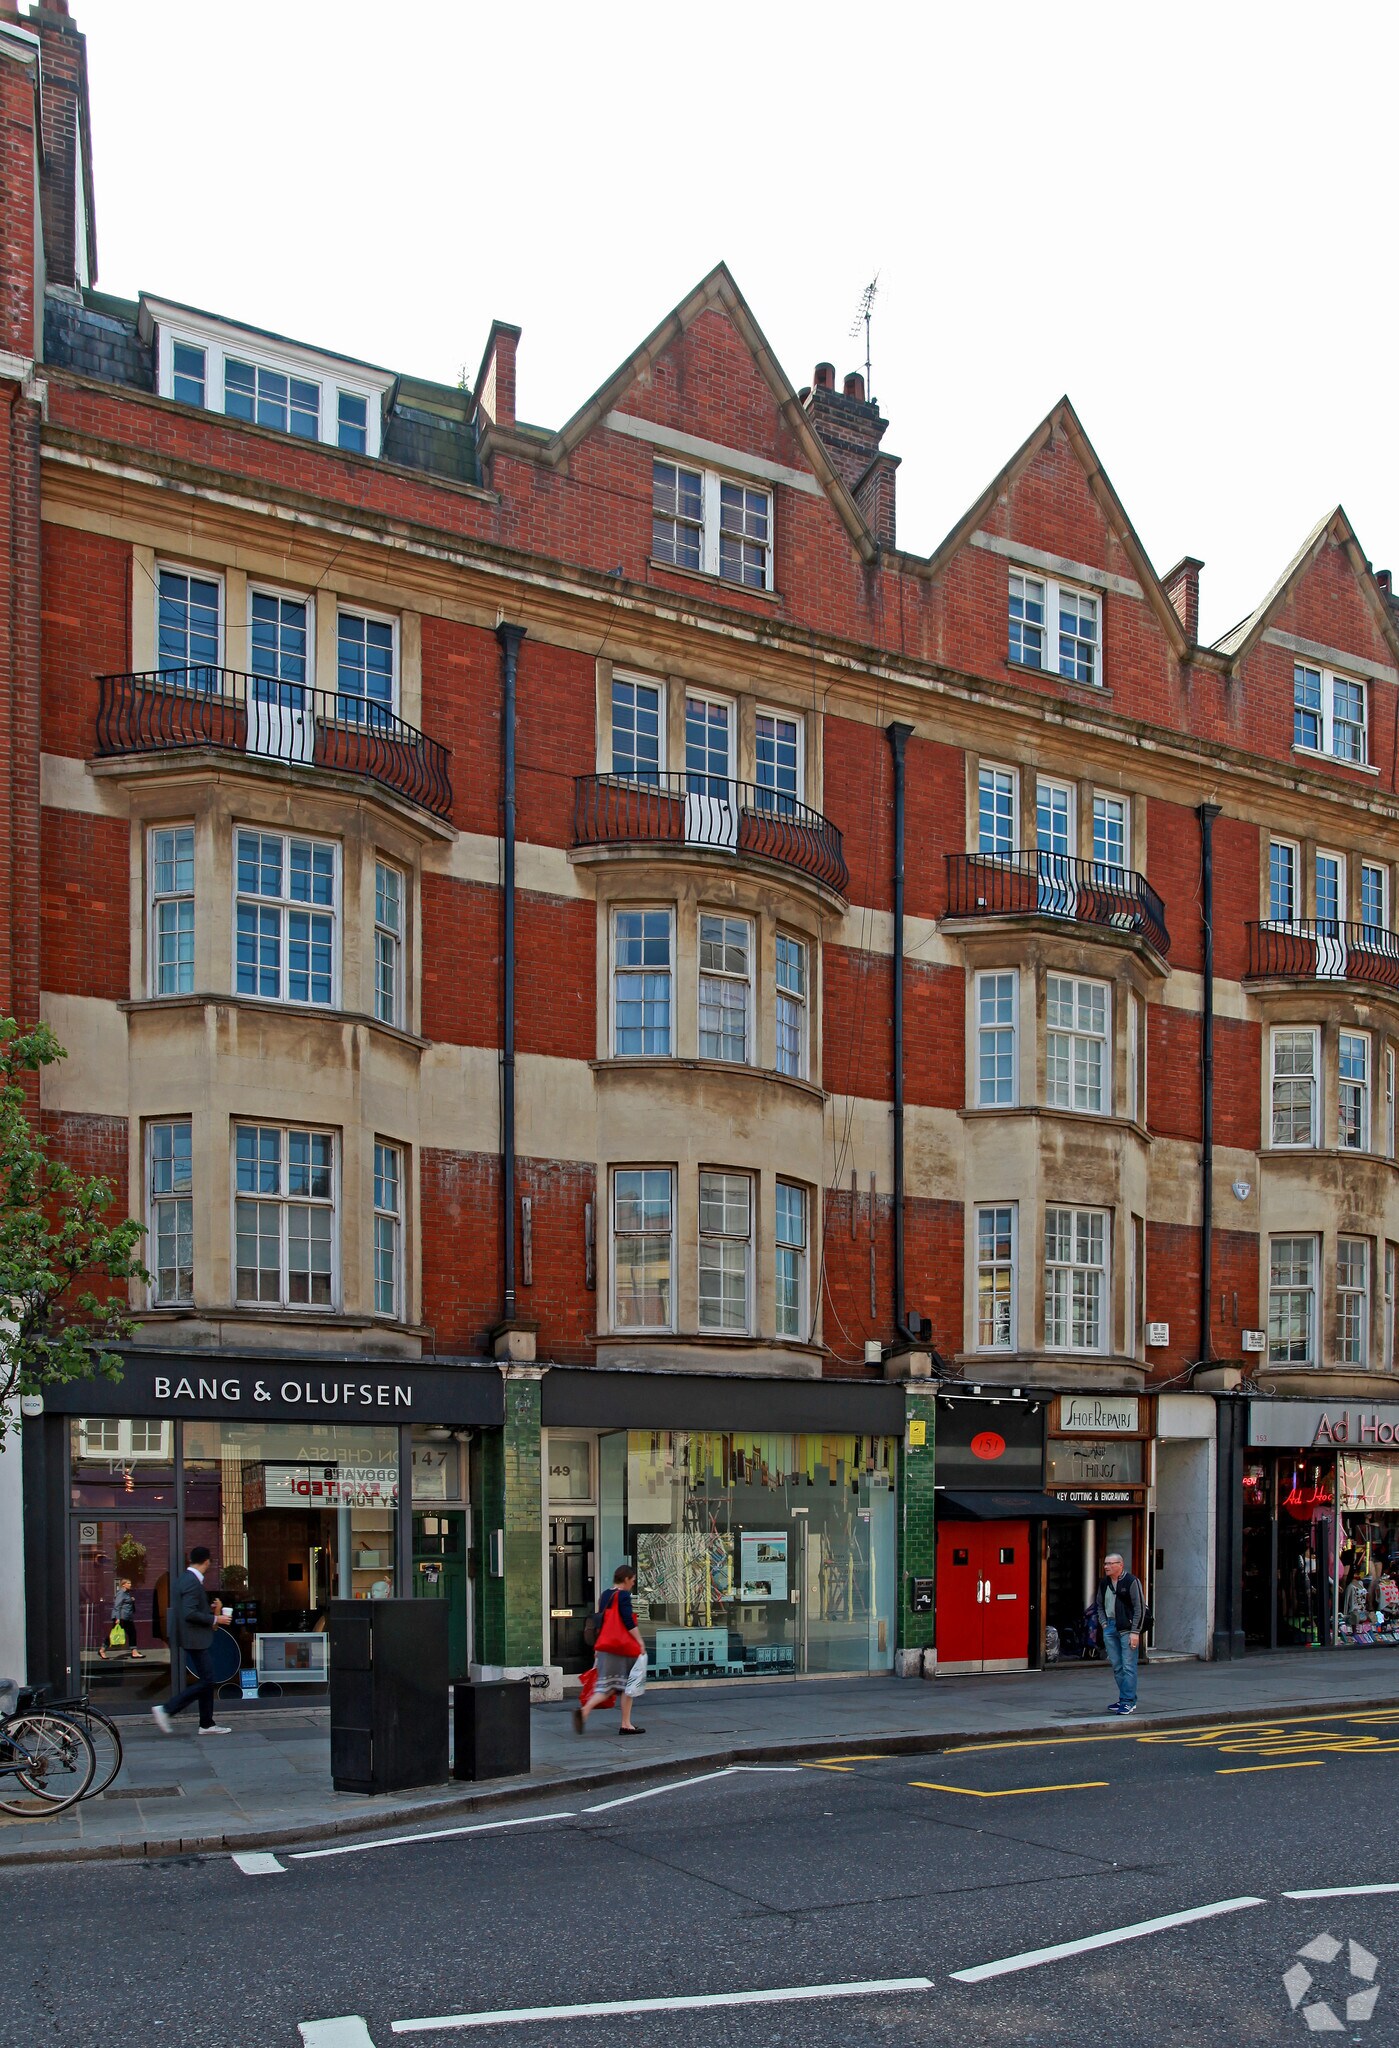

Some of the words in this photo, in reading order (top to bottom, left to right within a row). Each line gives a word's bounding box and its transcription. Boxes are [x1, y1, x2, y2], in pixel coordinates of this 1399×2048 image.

[155, 1376, 241, 1400] BANG
[253, 1380, 272, 1402] &
[280, 1381, 412, 1406] OLUFSEN
[1314, 1410, 1350, 1443] Ad
[978, 1438, 999, 1453] 151
[1256, 1434, 1267, 1442] 153
[106, 1458, 138, 1475] 147
[411, 1451, 448, 1467] 147
[549, 1465, 571, 1477] 149
[1056, 1491, 1068, 1501] KEY
[1069, 1491, 1093, 1501] CUTTING
[1094, 1491, 1100, 1501] &
[1100, 1491, 1130, 1501] ENGRAVING
[1282, 1488, 1303, 1505] Ad
[1306, 1485, 1333, 1503] Hoc
